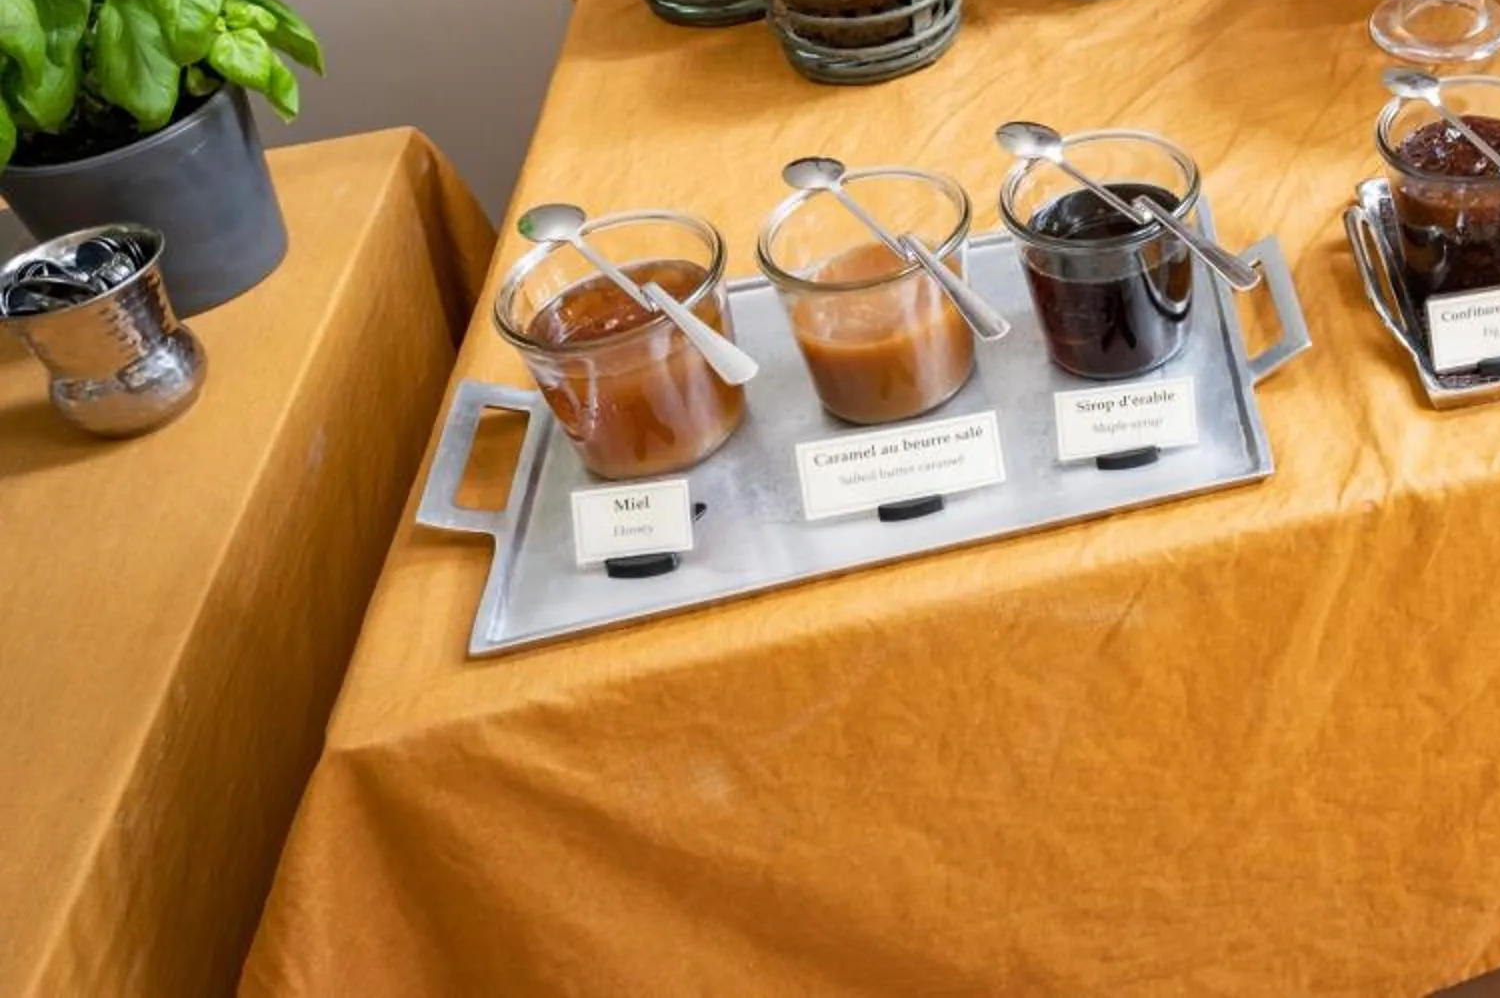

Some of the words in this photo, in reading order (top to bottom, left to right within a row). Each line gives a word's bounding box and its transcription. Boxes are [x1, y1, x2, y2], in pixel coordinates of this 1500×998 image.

[1075, 400, 1115, 413] Sirop
[813, 444, 876, 468] Caramel
[880, 445, 899, 455] au
[903, 434, 951, 452] beurre
[955, 425, 984, 441] salé
[879, 464, 915, 480] butter
[613, 495, 651, 511] Miel
[613, 525, 655, 538] Honey
